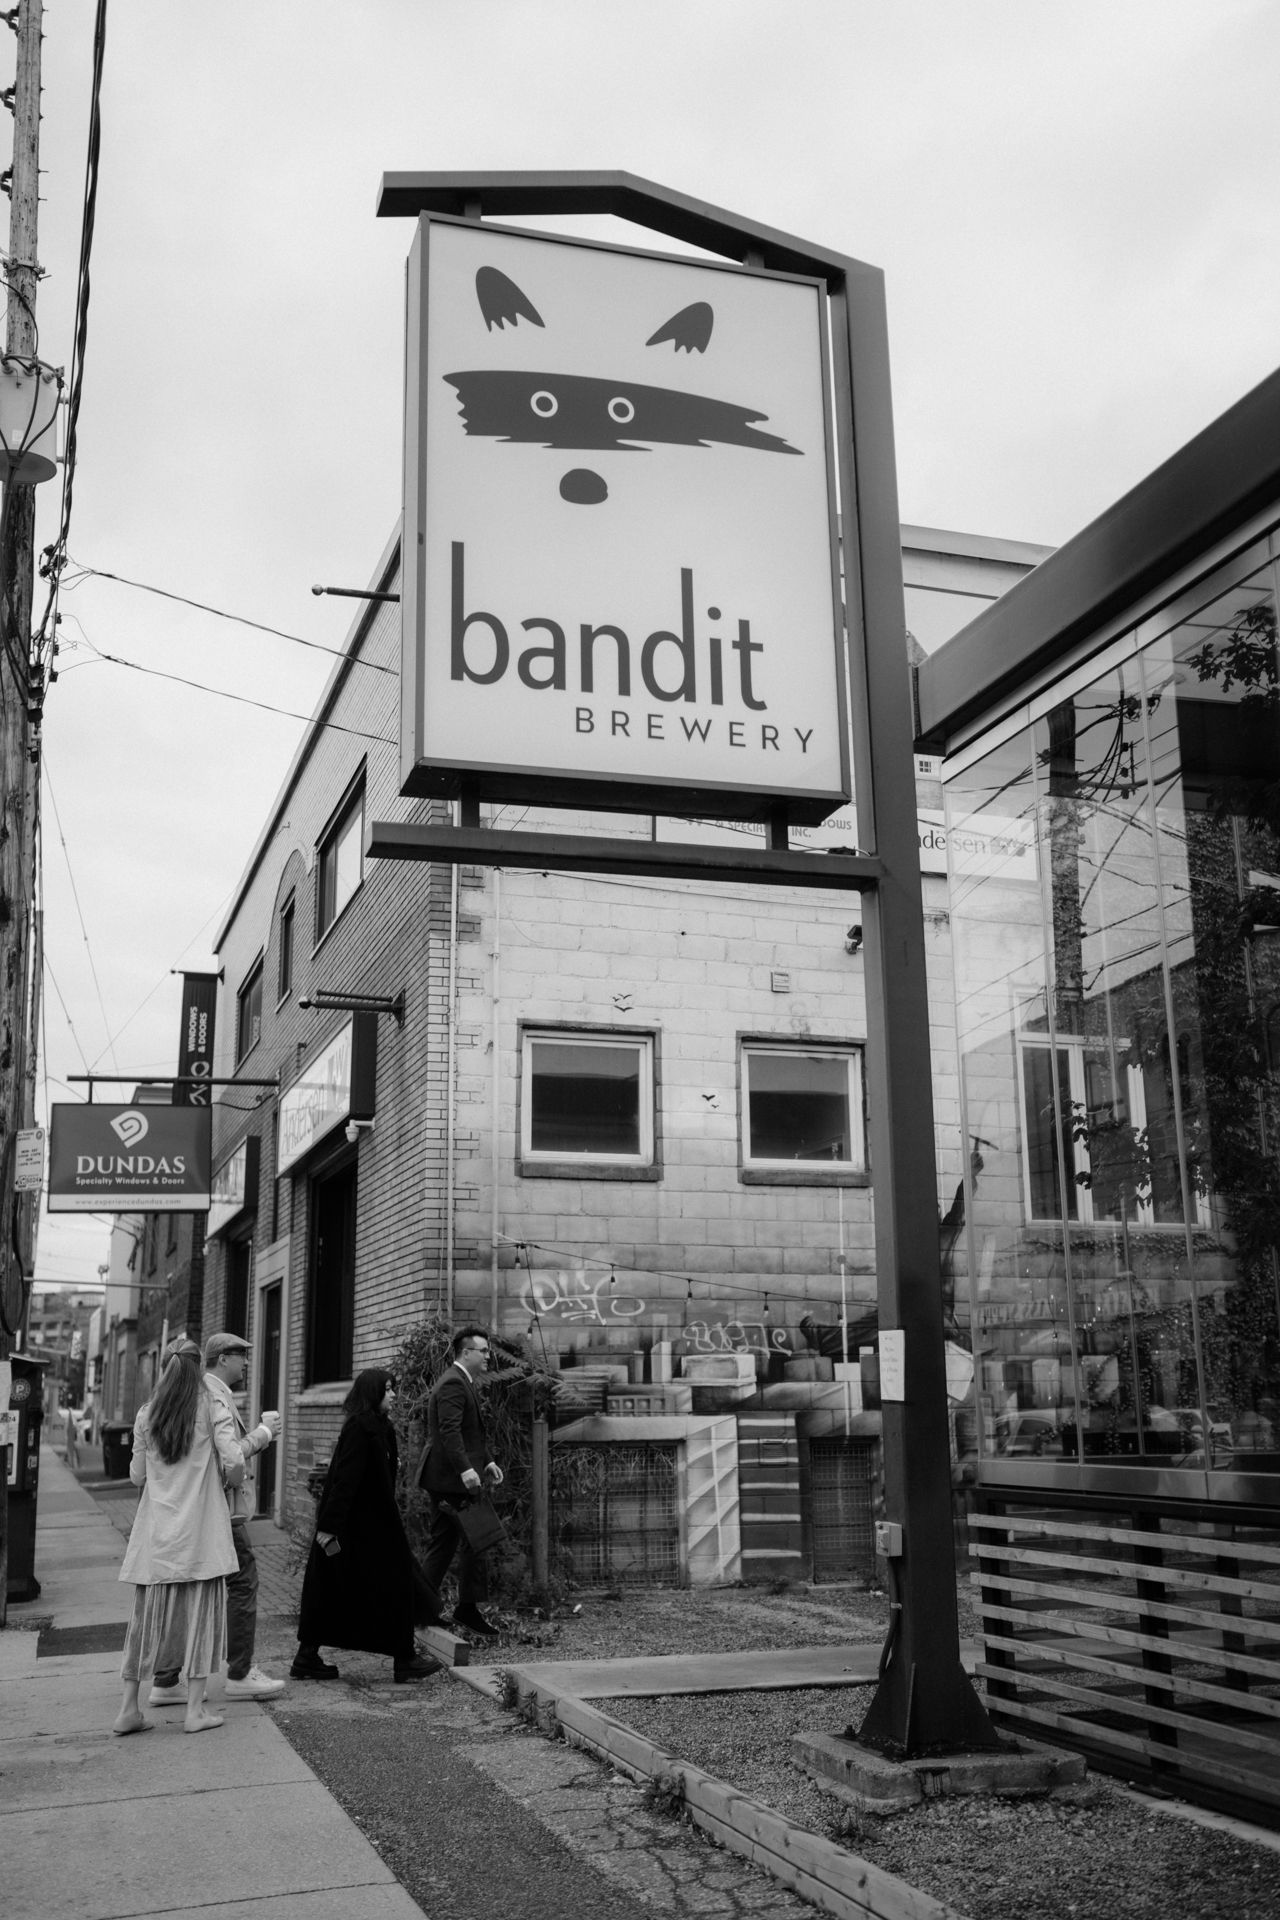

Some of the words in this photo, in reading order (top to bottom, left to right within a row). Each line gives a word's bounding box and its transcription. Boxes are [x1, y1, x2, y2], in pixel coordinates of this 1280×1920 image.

[450, 540, 768, 711] bandit
[574, 707, 814, 753] BREWERY
[187, 1005, 198, 1053] WINDOWS
[198, 1012, 208, 1045] DOORS
[75, 1177, 113, 1186] Specialty
[115, 1177, 150, 1185] Windows
[152, 1177, 159, 1185] &
[161, 1177, 185, 1185] Doors
[76, 1155, 186, 1175] DUNDAS
